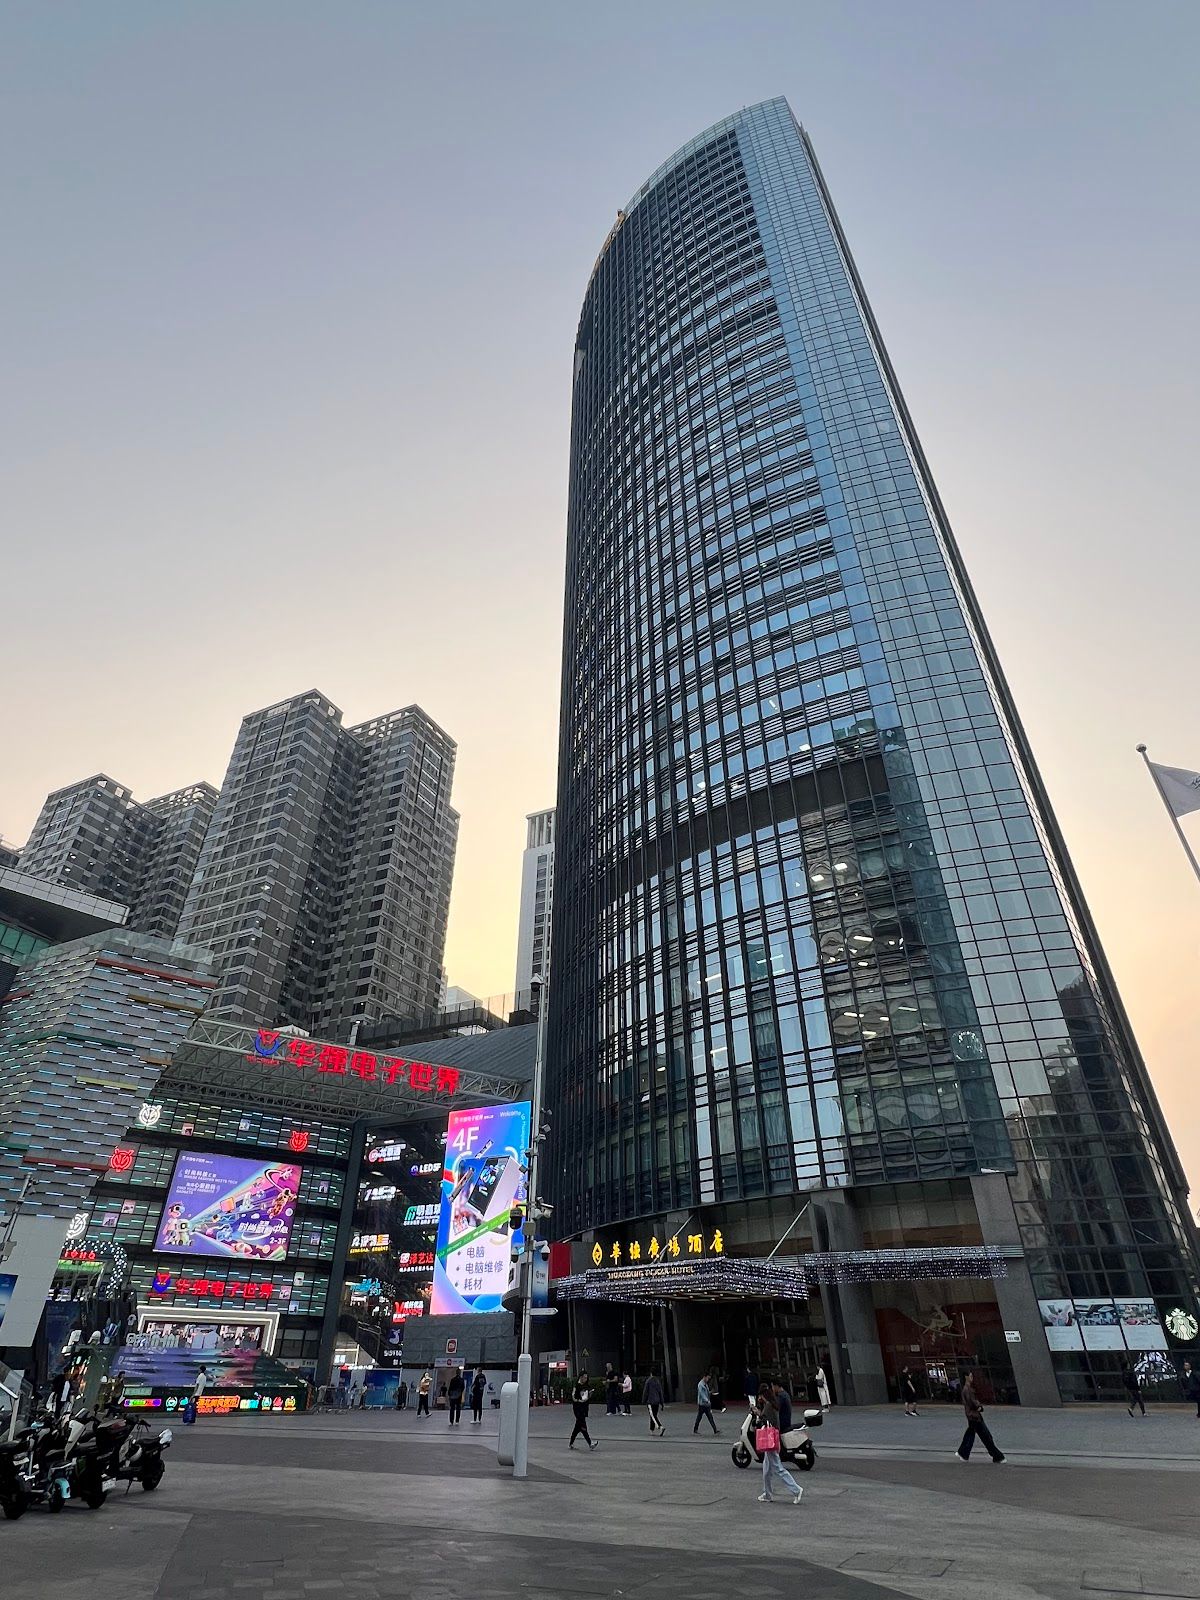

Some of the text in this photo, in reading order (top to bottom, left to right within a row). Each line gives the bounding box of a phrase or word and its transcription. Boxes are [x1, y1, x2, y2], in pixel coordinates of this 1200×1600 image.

[286, 1039, 460, 1097] 华强电子世界
[452, 1126, 480, 1152] 4F
[517, 1180, 525, 1199] World
[269, 1236, 287, 1245] 2-3F
[466, 1246, 485, 1259] 电脑
[465, 1261, 504, 1275] 电脑维修
[175, 1278, 274, 1299] 华强电子世界
[463, 1278, 483, 1291] 耗材
